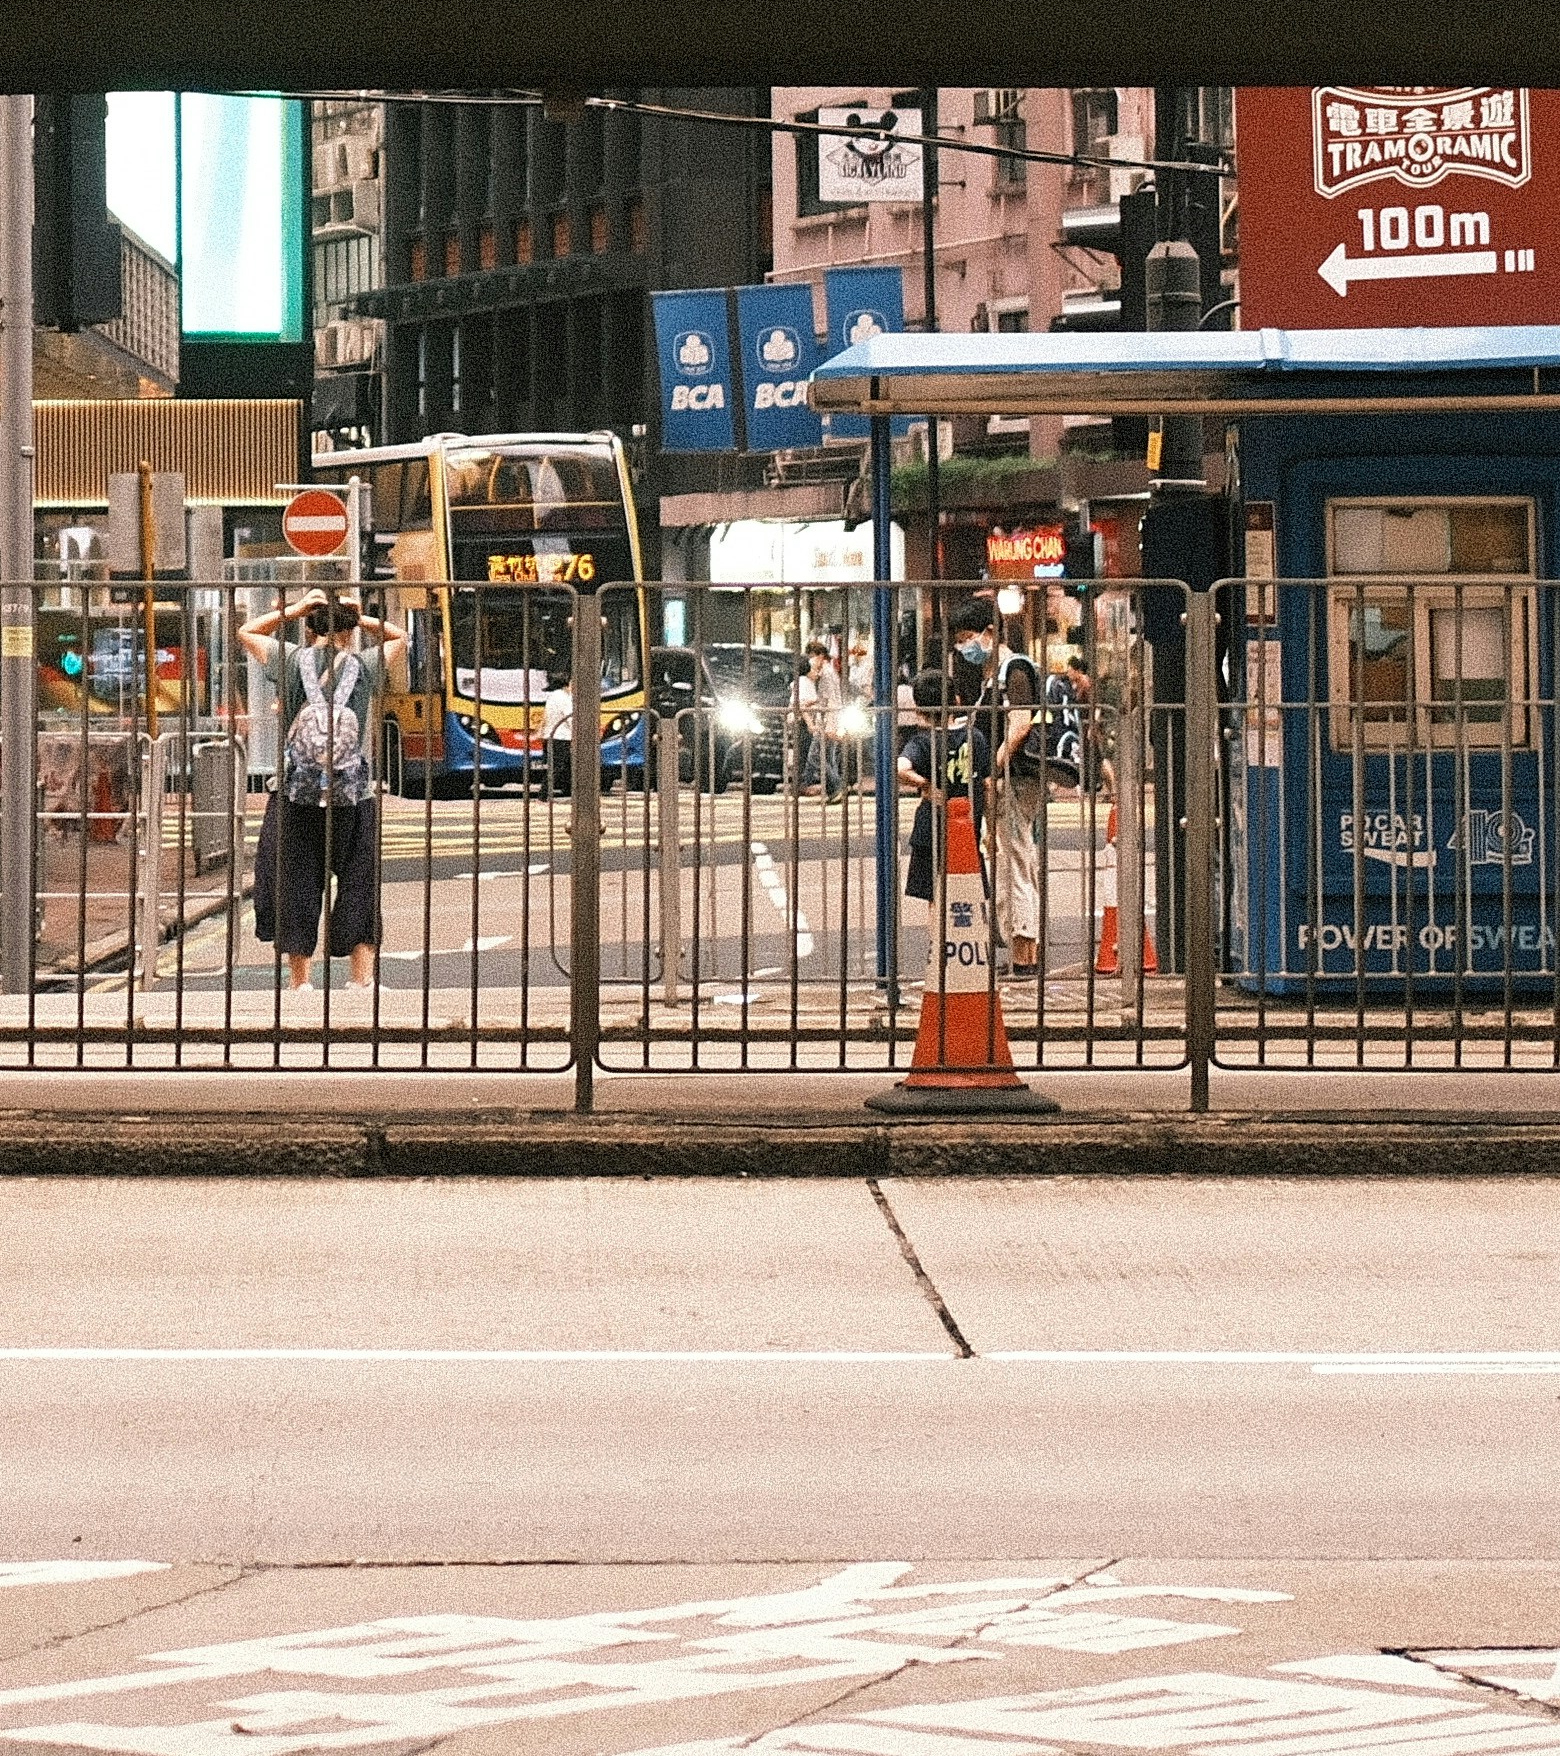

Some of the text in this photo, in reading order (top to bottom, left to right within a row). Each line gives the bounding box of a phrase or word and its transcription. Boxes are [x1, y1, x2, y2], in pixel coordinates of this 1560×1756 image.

[1326, 91, 1515, 137] 電車全景遊
[1327, 132, 1518, 177] TRAMORAMIC
[1401, 157, 1443, 175] TOUR
[1357, 204, 1491, 251] 100m
[671, 384, 725, 411] BCA
[1298, 924, 1408, 950] POWER
